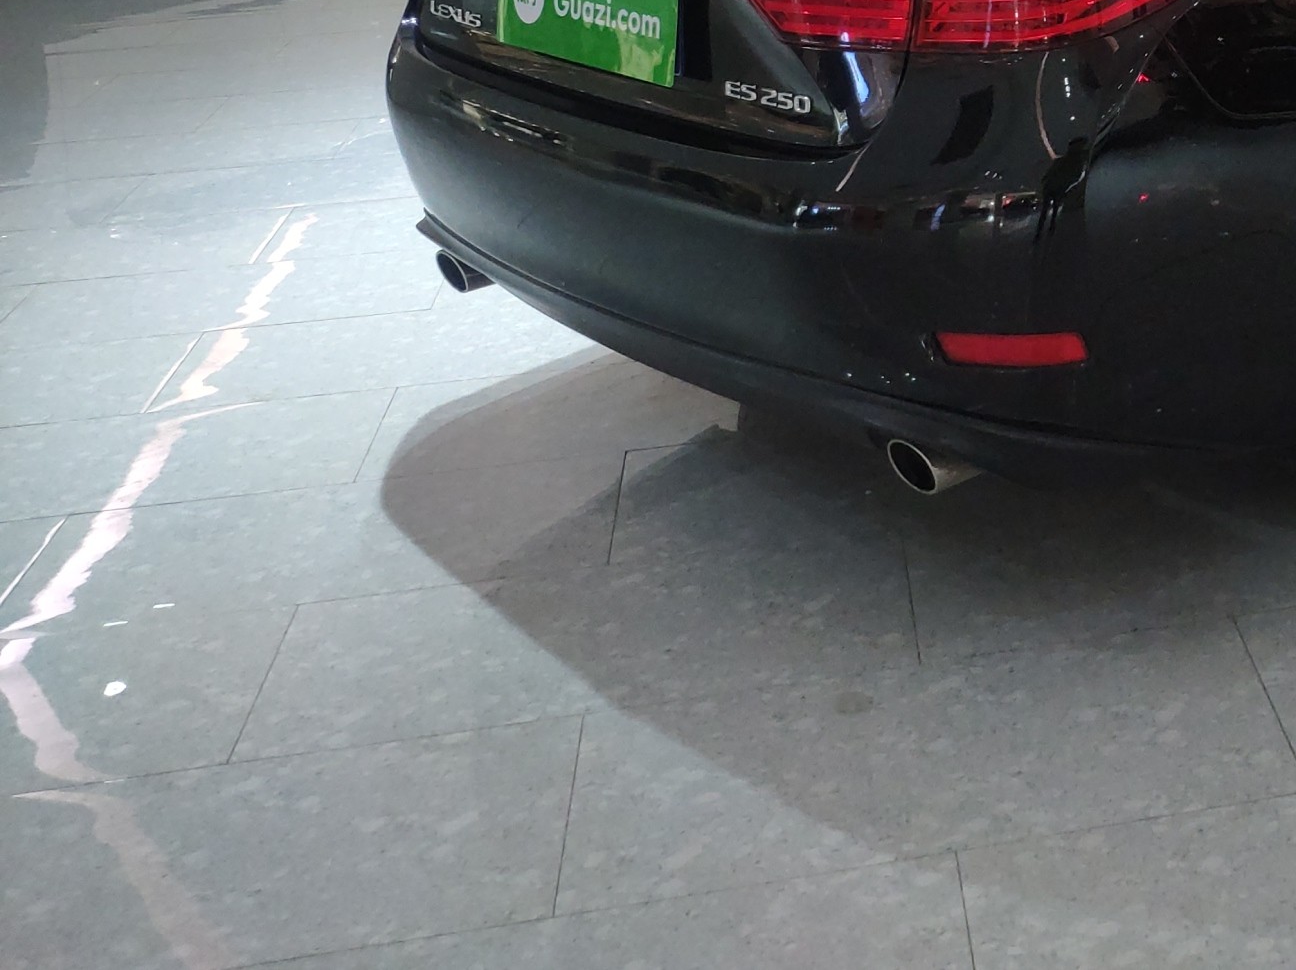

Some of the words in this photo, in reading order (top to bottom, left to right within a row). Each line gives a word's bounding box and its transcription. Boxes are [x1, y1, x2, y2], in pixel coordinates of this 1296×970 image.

[431, 0, 482, 28] LEXUS
[724, 80, 757, 102] ES
[760, 91, 812, 114] 250
